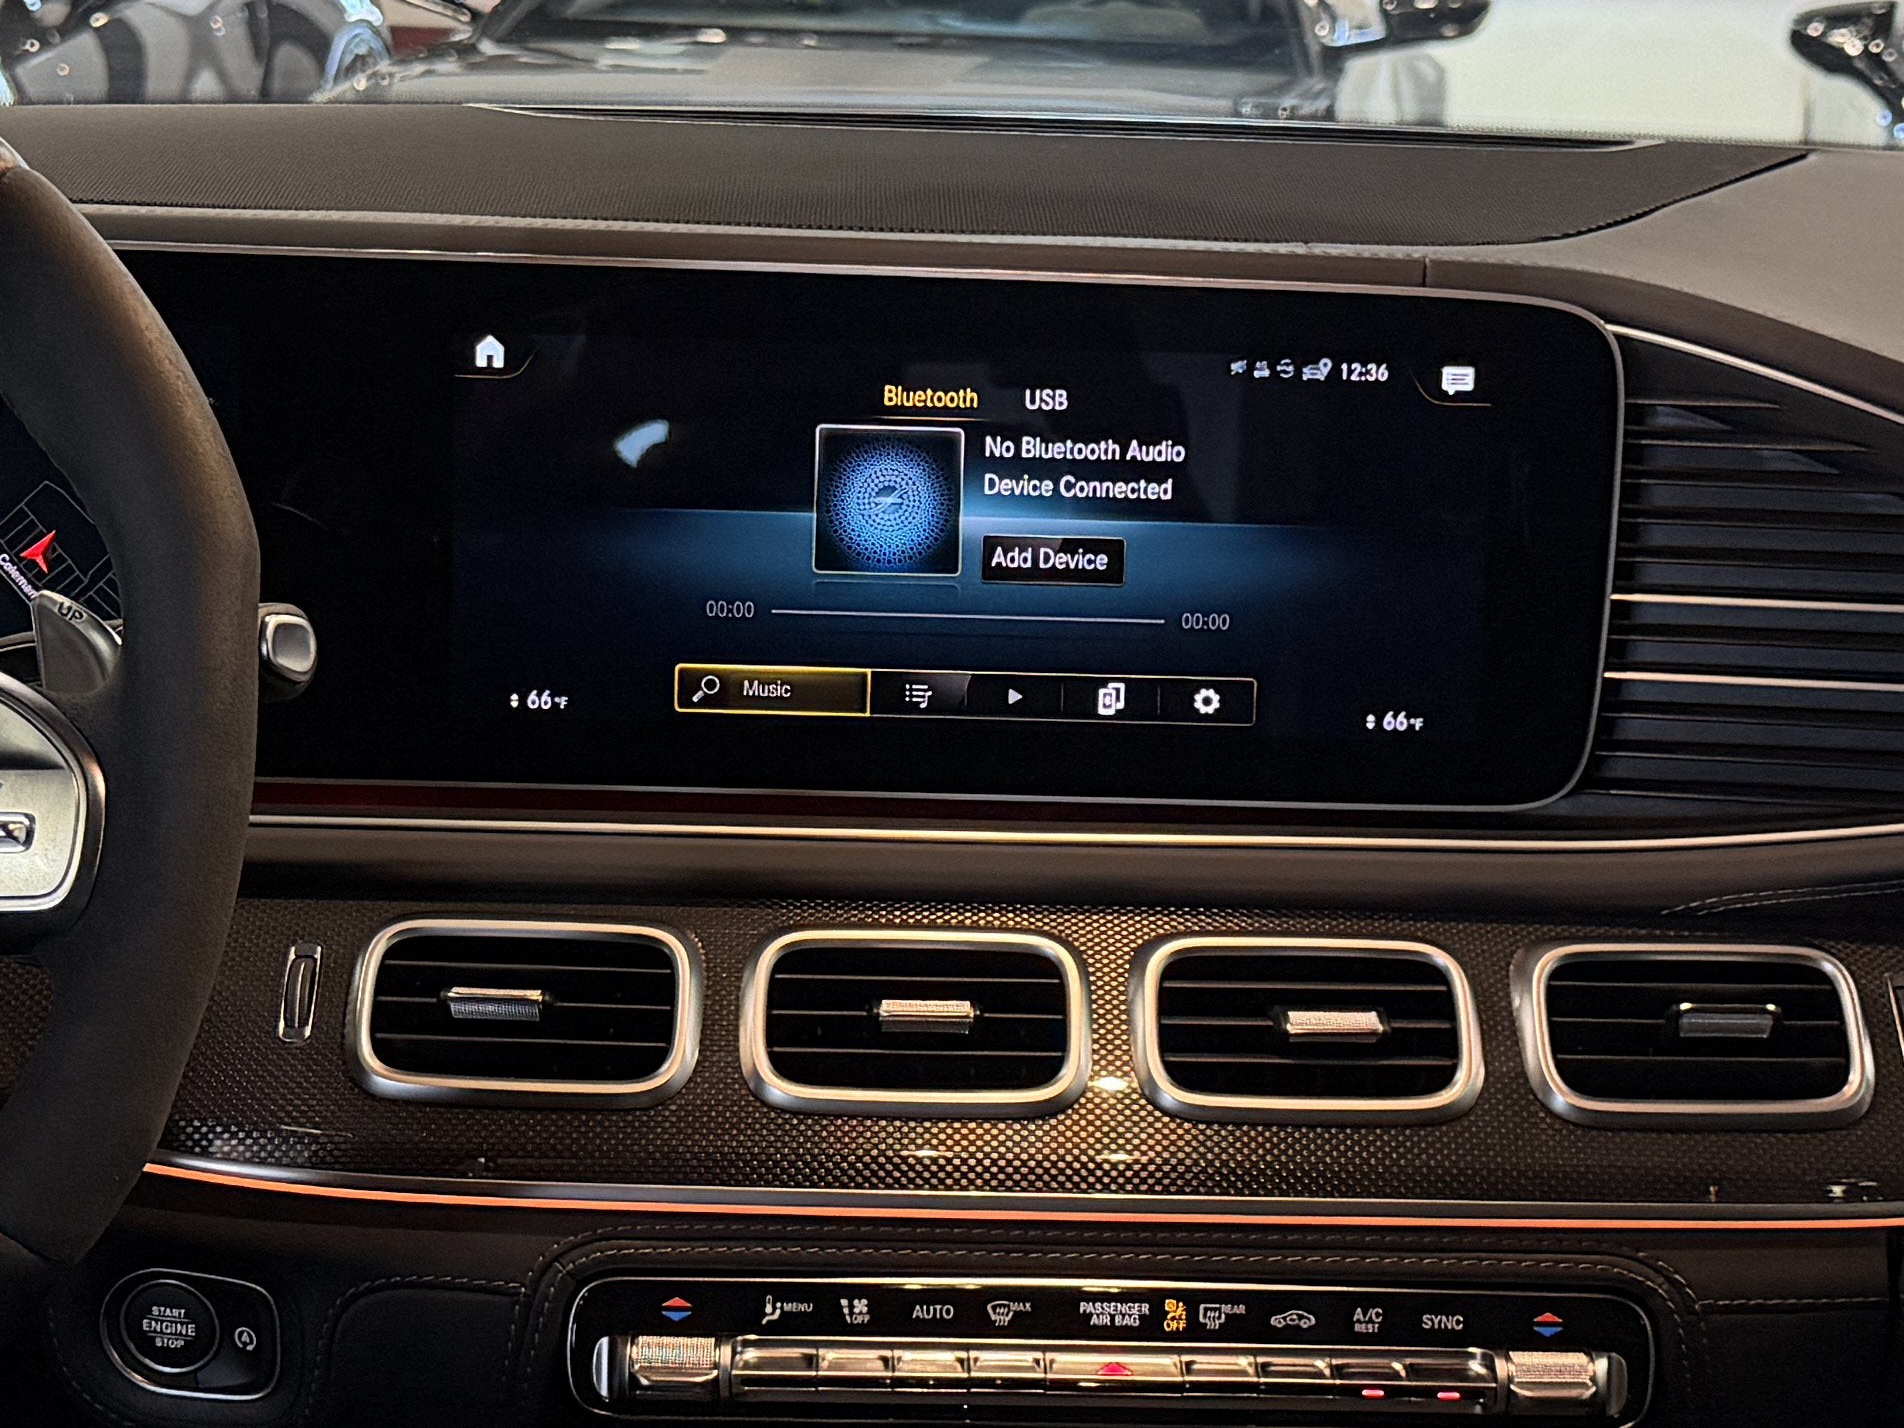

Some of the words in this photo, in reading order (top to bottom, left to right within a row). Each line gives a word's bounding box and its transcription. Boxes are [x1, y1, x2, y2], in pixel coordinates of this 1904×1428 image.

[1339, 361, 1389, 383] 12:36
[883, 384, 979, 409] Bluetooth
[1024, 388, 1069, 412] USB
[983, 436, 1015, 460] No
[1020, 437, 1121, 463] Bluetooth
[1126, 439, 1186, 464] Audio
[983, 474, 1054, 498] Device
[1059, 475, 1173, 501] Connected
[991, 547, 1033, 570] Add
[1039, 547, 1109, 571] Device
[57, 602, 84, 622] UP
[705, 600, 755, 620] 00:00
[1181, 612, 1231, 632] 00:00
[742, 678, 792, 699] Music
[151, 1306, 186, 1319] START
[783, 1301, 813, 1314] MENU
[913, 1303, 954, 1321] AUTO
[1010, 1301, 1032, 1313] MAX
[1079, 1301, 1150, 1315] PASSENGER
[1222, 1304, 1246, 1315] REAR
[1353, 1307, 1383, 1324] A/C
[851, 1312, 871, 1324] OFF
[1090, 1314, 1112, 1327] AIR
[1115, 1314, 1140, 1328] BAG
[1163, 1319, 1187, 1331] OFF
[1421, 1313, 1464, 1330] SYNC
[142, 1319, 196, 1336] ENGINE
[1355, 1323, 1380, 1333] REST
[155, 1338, 185, 1348] STOP
